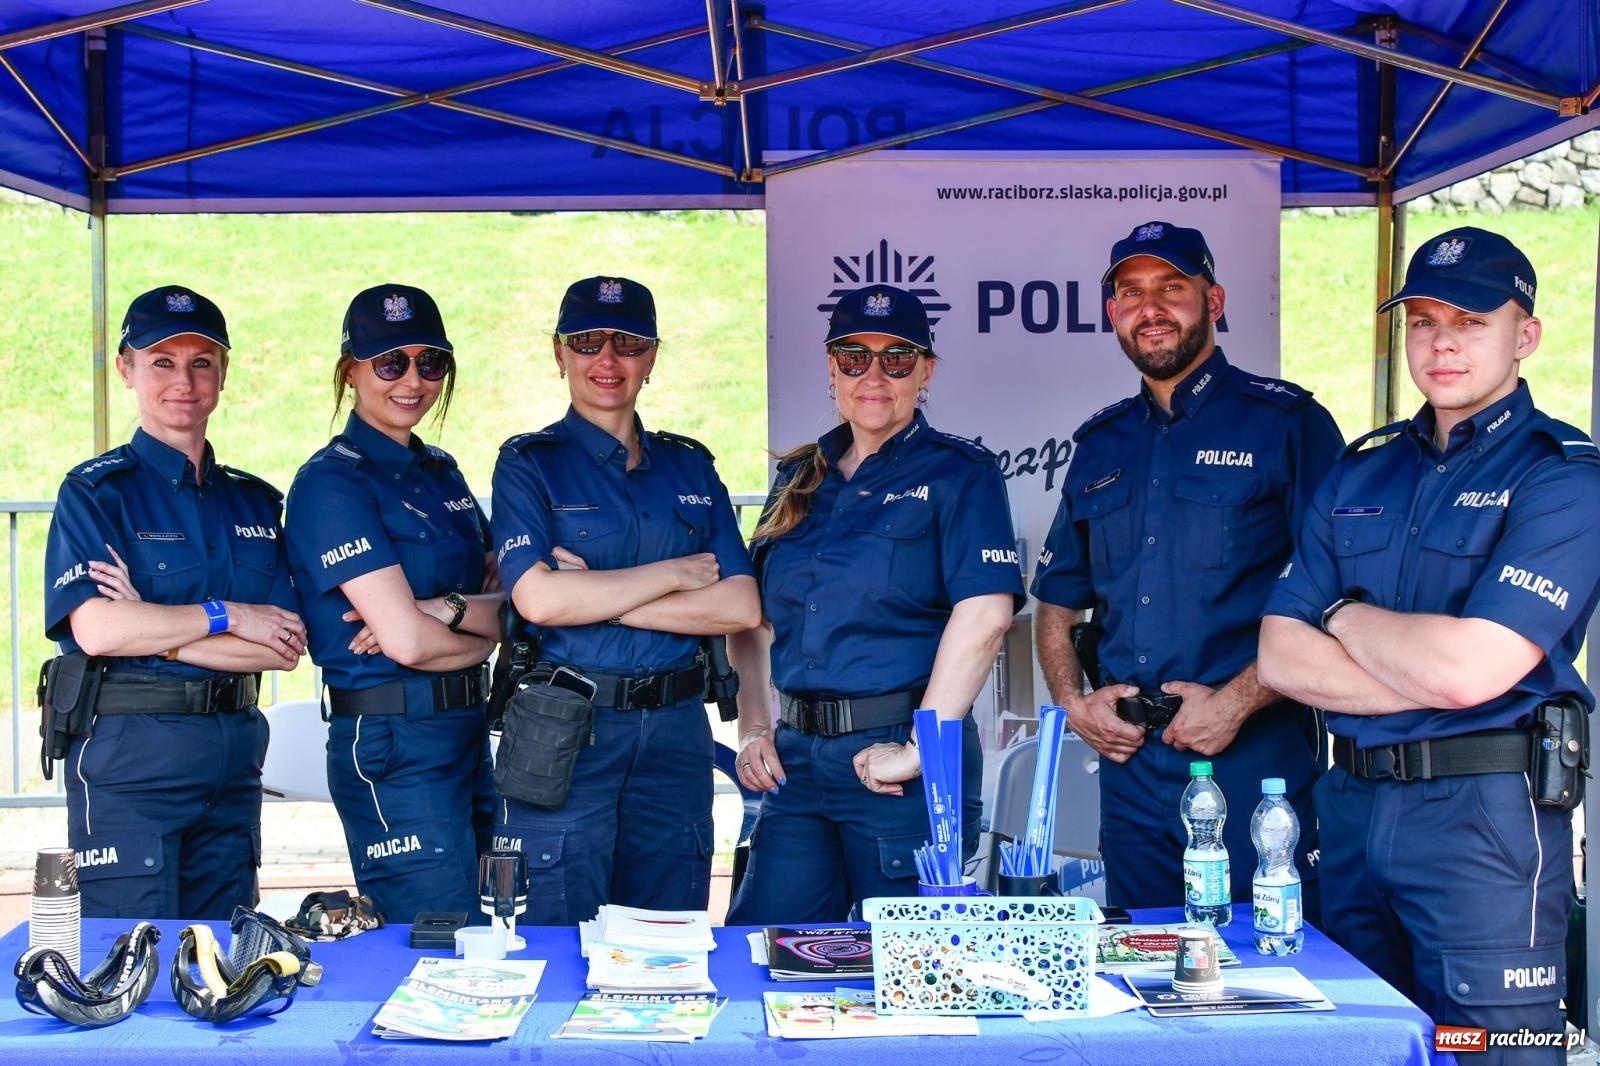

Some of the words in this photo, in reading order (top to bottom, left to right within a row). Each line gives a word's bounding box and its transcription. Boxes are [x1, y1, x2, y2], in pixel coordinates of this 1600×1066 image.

[937, 184, 1228, 202] www.raciborz.slaska.policja.gov.pl
[1191, 373, 1212, 396] POLICJA
[1195, 450, 1253, 468] POLICJA
[234, 524, 277, 540] POLICJ
[320, 536, 372, 569] POLICJA
[981, 549, 1018, 564] POLIC
[1498, 564, 1569, 611] POLICJA
[74, 846, 119, 869] OLICJA
[366, 834, 422, 860] POLICJA
[1504, 966, 1556, 989] POLICJA
